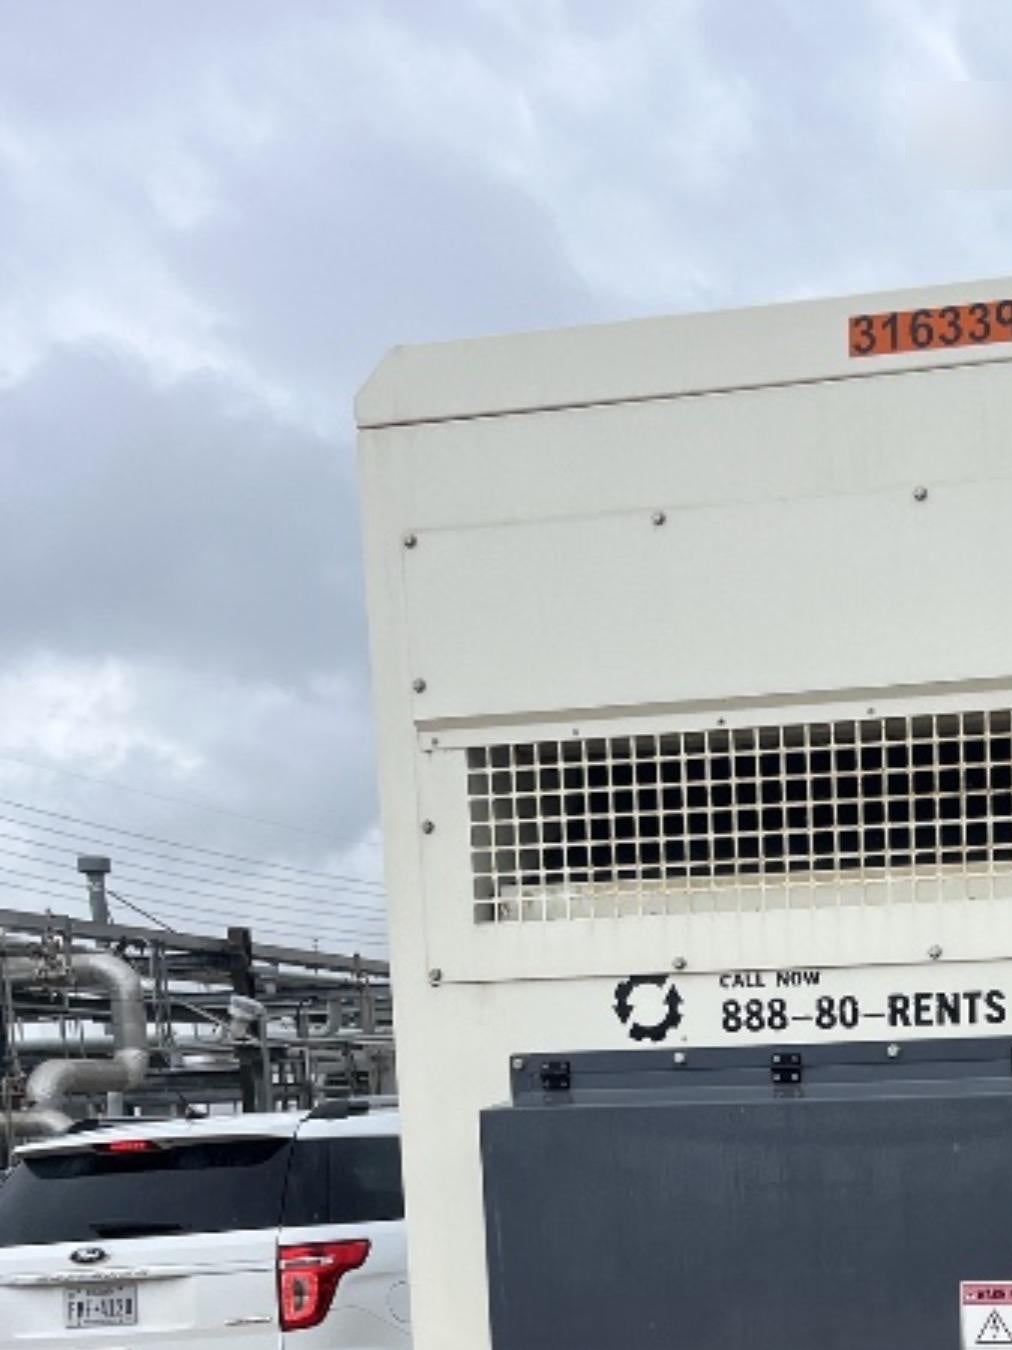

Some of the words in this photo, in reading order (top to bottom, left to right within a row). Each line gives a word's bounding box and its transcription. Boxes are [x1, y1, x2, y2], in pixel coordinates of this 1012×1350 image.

[719, 973, 766, 988] CALL
[776, 971, 820, 987] NOW
[722, 989, 1006, 1032] 888-80-RENTS
